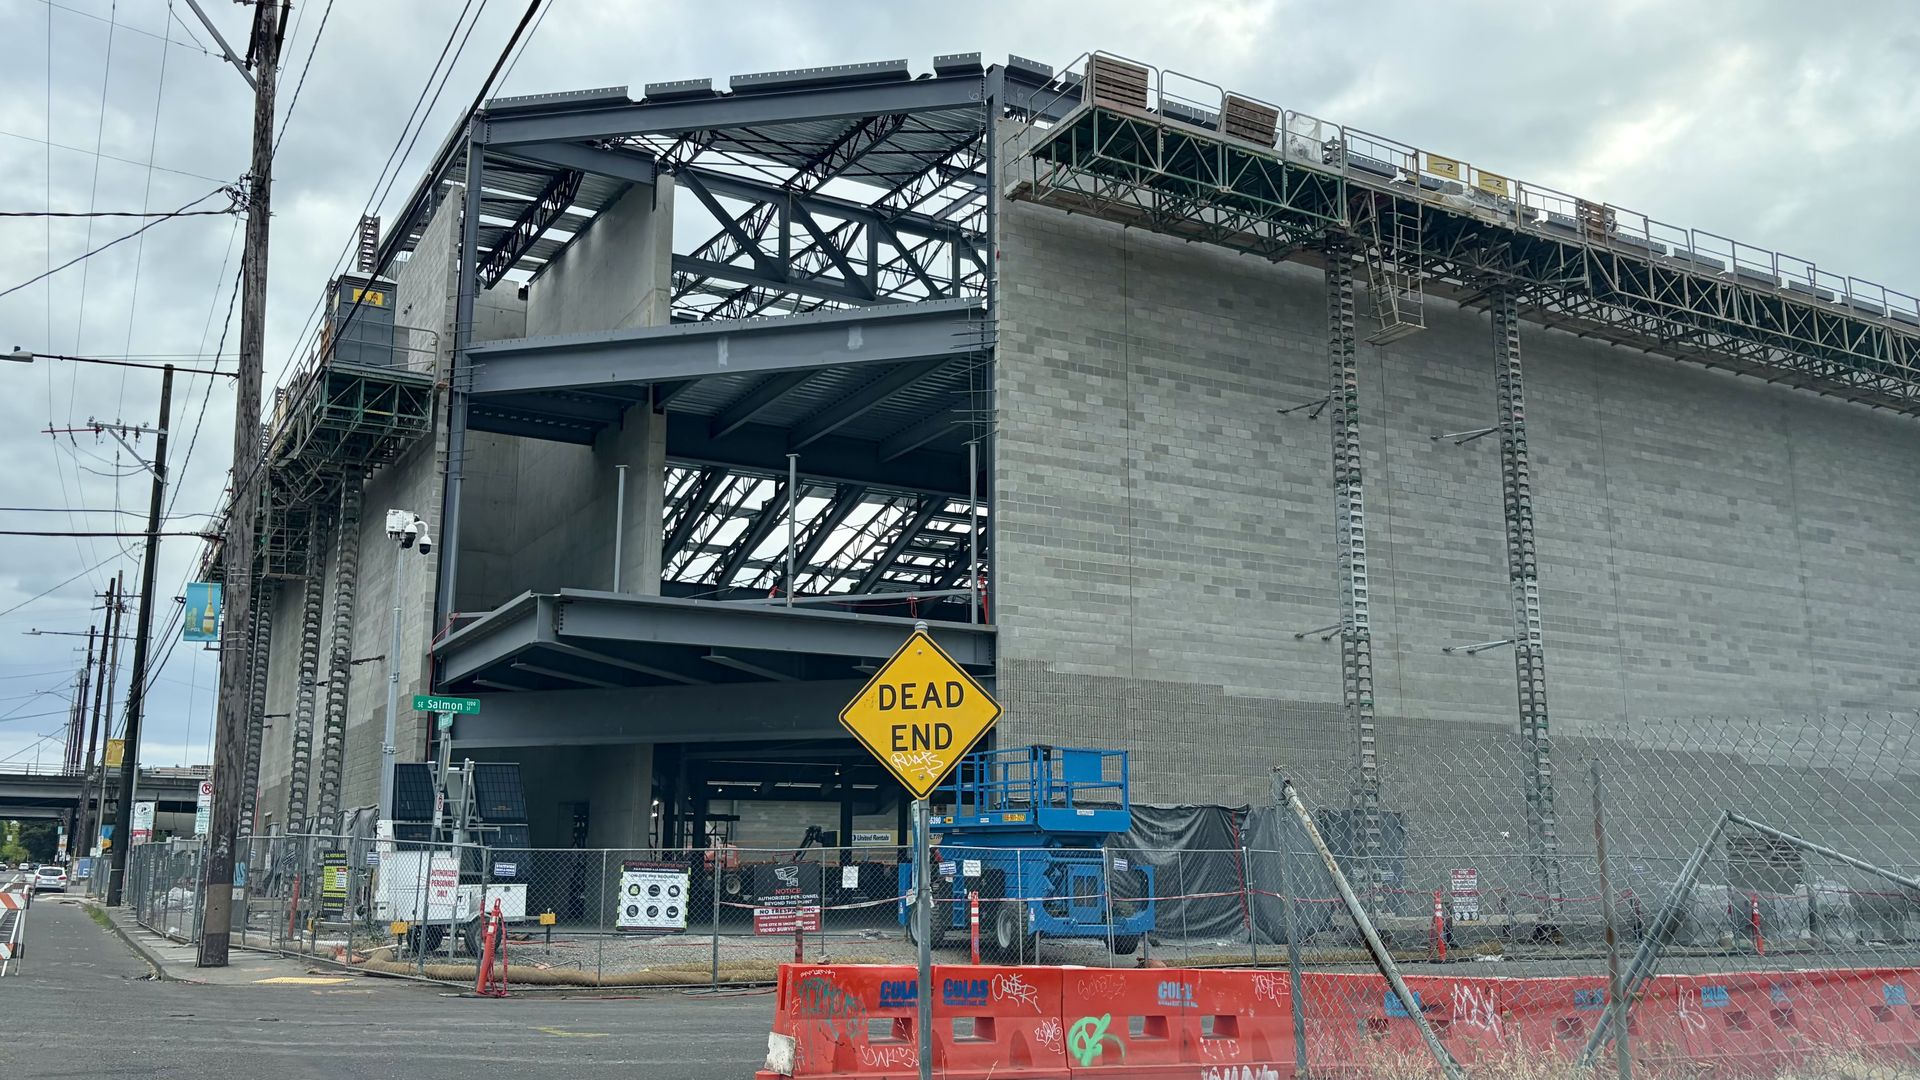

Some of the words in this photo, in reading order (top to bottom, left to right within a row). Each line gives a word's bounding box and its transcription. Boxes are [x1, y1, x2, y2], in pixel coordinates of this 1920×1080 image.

[427, 699, 463, 711] Salmon
[879, 681, 964, 711] DEAD
[892, 723, 952, 752] END
[431, 869, 457, 877] AUTHORIZED
[943, 978, 989, 999] COLAS
